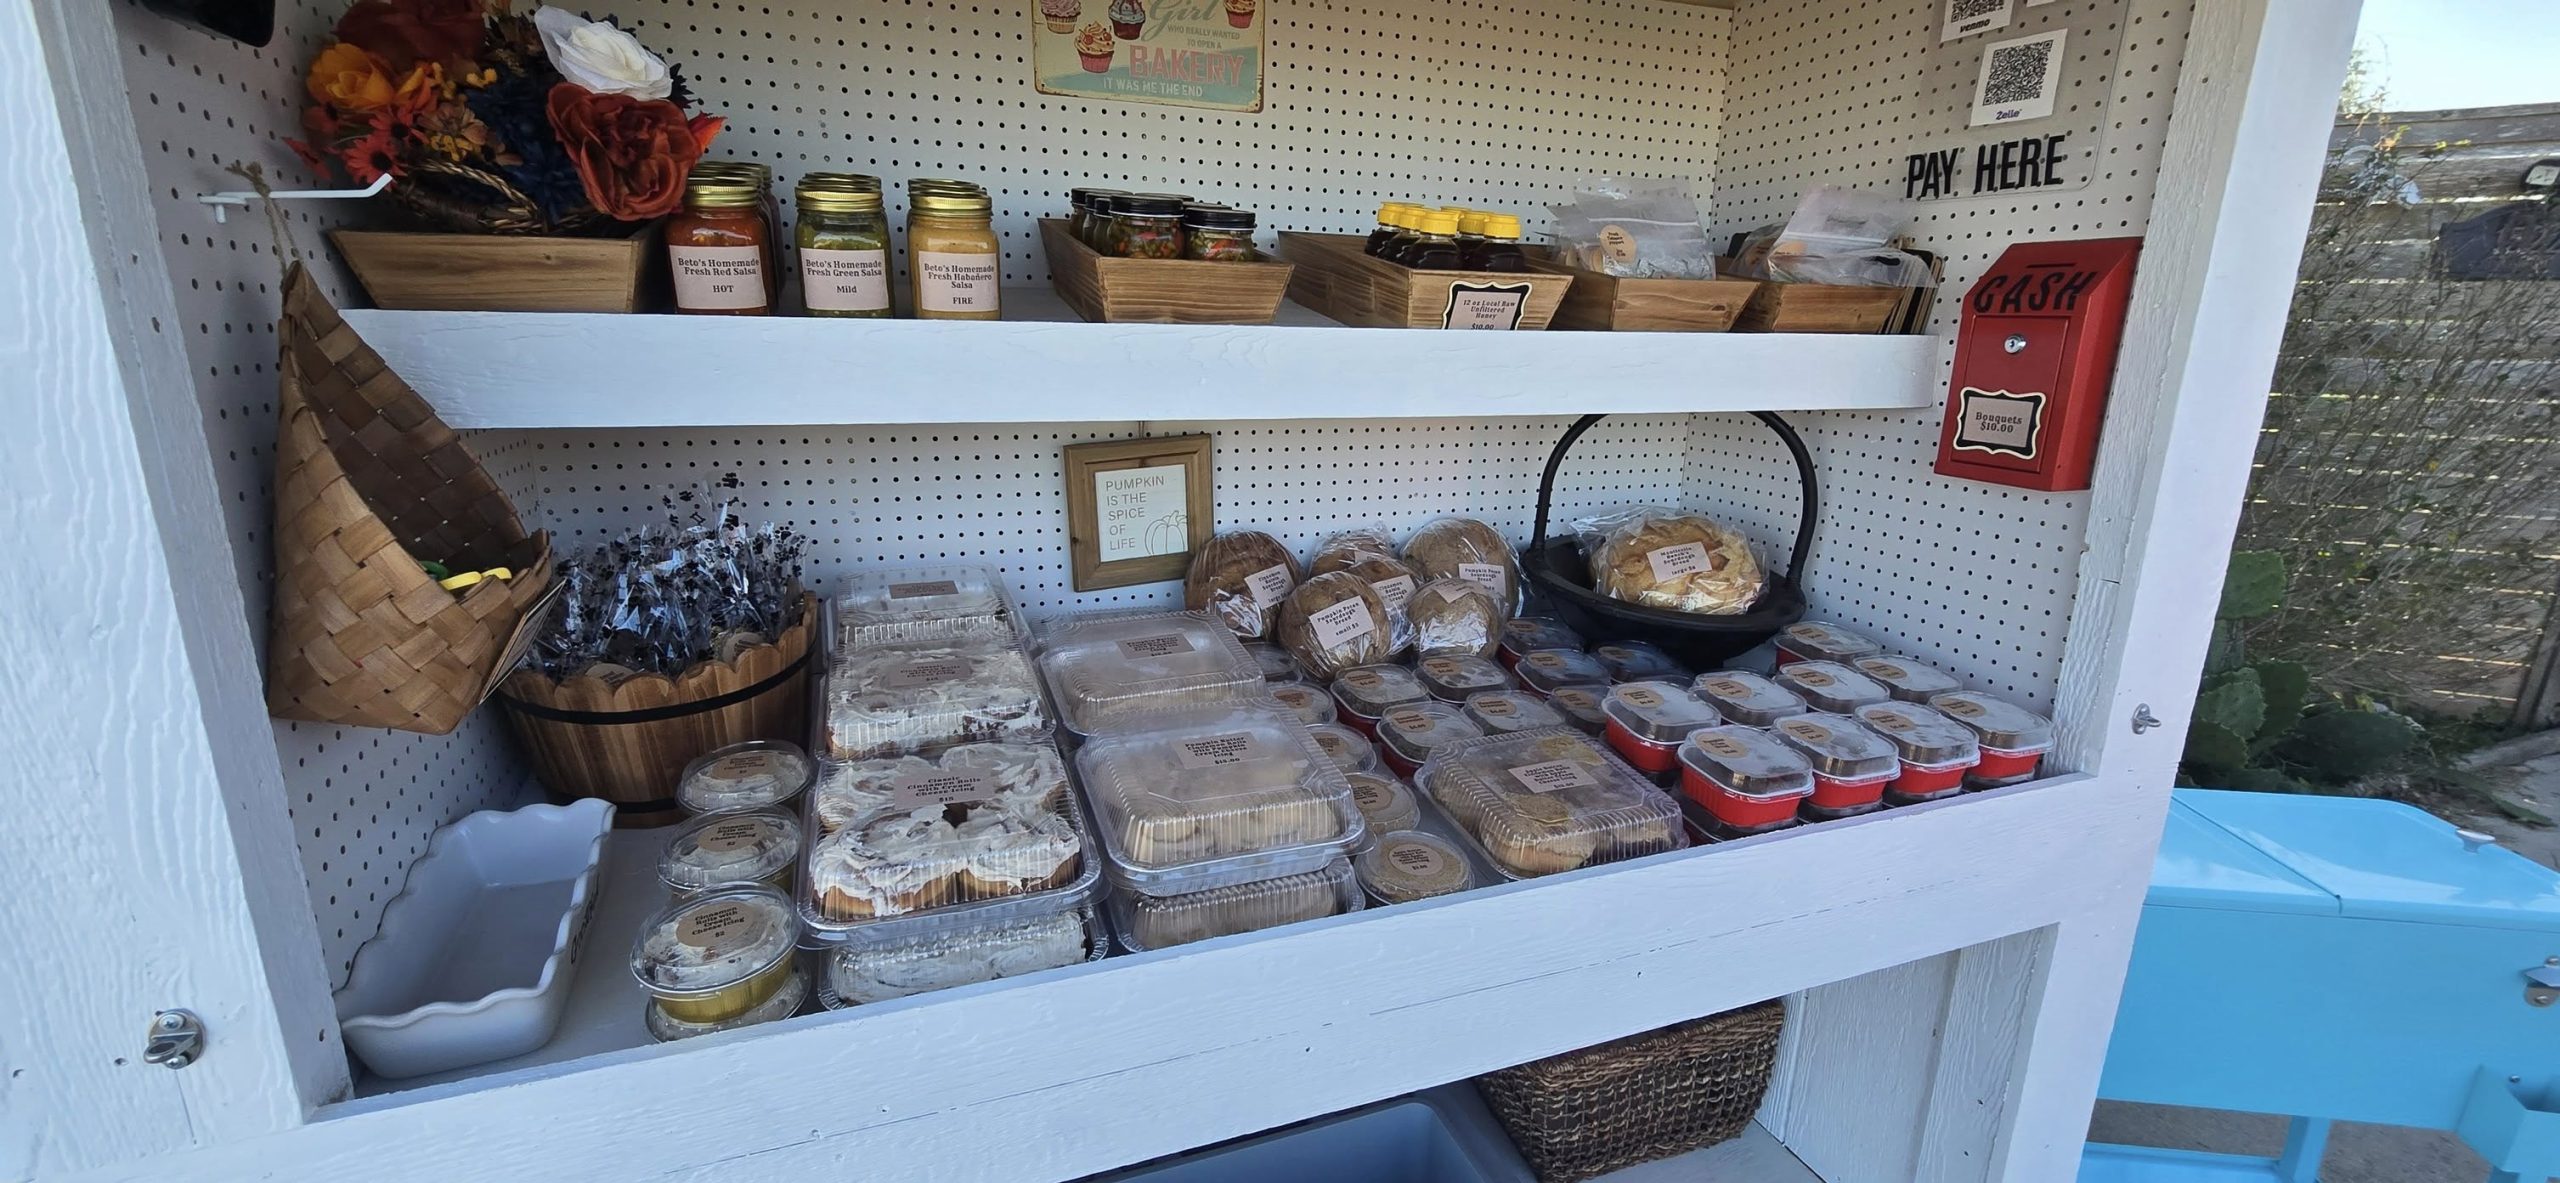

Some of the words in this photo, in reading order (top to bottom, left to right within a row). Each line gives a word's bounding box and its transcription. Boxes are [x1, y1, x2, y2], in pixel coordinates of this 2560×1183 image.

[1960, 19, 1990, 32] venmo
[1168, 25, 1184, 33] WHO
[1186, 26, 1211, 36] REALLY
[1212, 30, 1240, 40] WANTED
[1188, 39, 1196, 47] TO
[1197, 40, 1214, 49] OPEN
[1129, 45, 1244, 87] BAKERY
[1103, 78, 1113, 89] IT
[1117, 79, 1138, 91] WAS
[1142, 81, 1157, 93] ME
[1160, 82, 1179, 95] THE
[1181, 84, 1203, 97] END
[1996, 109, 2019, 120] Zelle
[1906, 148, 1959, 198] PAY
[1974, 135, 2065, 194] HERE
[677, 258, 705, 267] Beto's
[708, 259, 758, 268] Homemade
[806, 259, 830, 268] Beto's
[833, 260, 881, 269] Homemade
[924, 263, 948, 272] Beto's
[950, 264, 994, 273] Homemade
[684, 267, 709, 275] Fresh
[712, 267, 730, 275] Red
[733, 267, 757, 276] Salsa
[807, 268, 831, 276] Fresh
[833, 268, 858, 277] Green
[861, 268, 882, 276] Salsa
[928, 271, 951, 280] Fresh
[712, 285, 734, 293] HOT
[836, 285, 857, 294] Mild
[951, 281, 973, 289] Salsa
[1974, 271, 2099, 314] CASH
[952, 296, 973, 305] FIRE
[1976, 411, 2023, 425] Bouquets
[1980, 422, 2014, 433] $10.00
[1106, 475, 1165, 491] PUMPKIN
[1107, 495, 1118, 506] IS
[1122, 492, 1147, 504] THE
[1108, 507, 1145, 521] SPICE
[1110, 524, 1126, 535] OF
[1110, 537, 1136, 550] LIFE
[1664, 554, 1696, 564] Sourdough
[1317, 608, 1342, 622] Pumpkin
[1343, 602, 1359, 611] Pecan
[1326, 608, 1355, 624] Sourdough
[1334, 615, 1351, 626] Bread
[1336, 625, 1351, 636] small
[907, 781, 954, 790] Cinnamon
[916, 789, 948, 797] Cheese
[695, 906, 737, 921] Cinnamon
[696, 916, 717, 925] Rolls
[719, 911, 737, 919] with
[692, 924, 722, 936] Cheese
[724, 917, 745, 926] Icing
[704, 917, 731, 927] Cream
